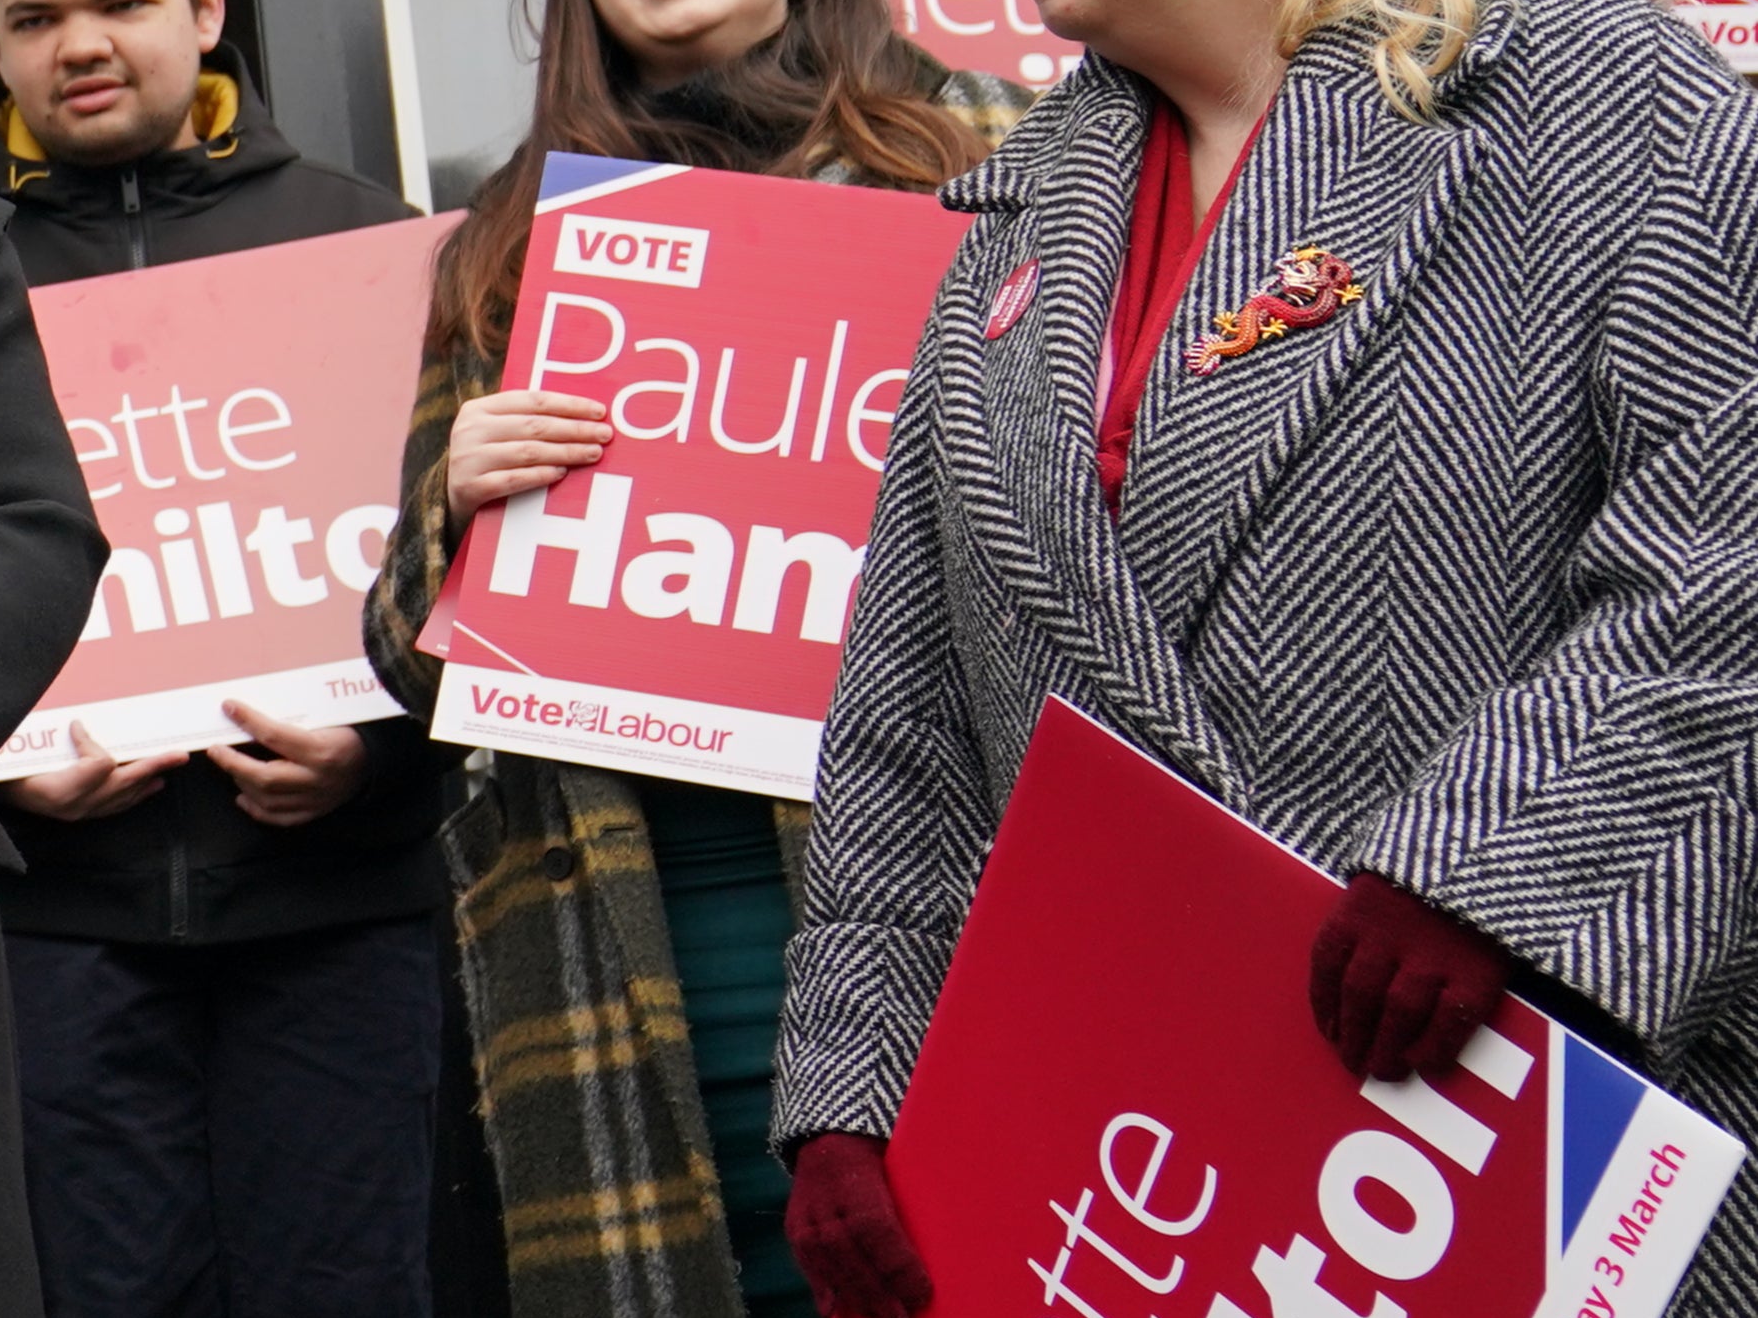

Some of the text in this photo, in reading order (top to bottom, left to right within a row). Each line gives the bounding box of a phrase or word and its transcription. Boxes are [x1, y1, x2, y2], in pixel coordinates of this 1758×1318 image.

[577, 229, 692, 273] VOTE
[528, 291, 911, 473] Paule
[66, 384, 297, 501] ette
[472, 685, 563, 727] Vote
[599, 707, 733, 754] Labour
[1608, 1140, 1687, 1256] March
[1594, 1256, 1625, 1288] 3
